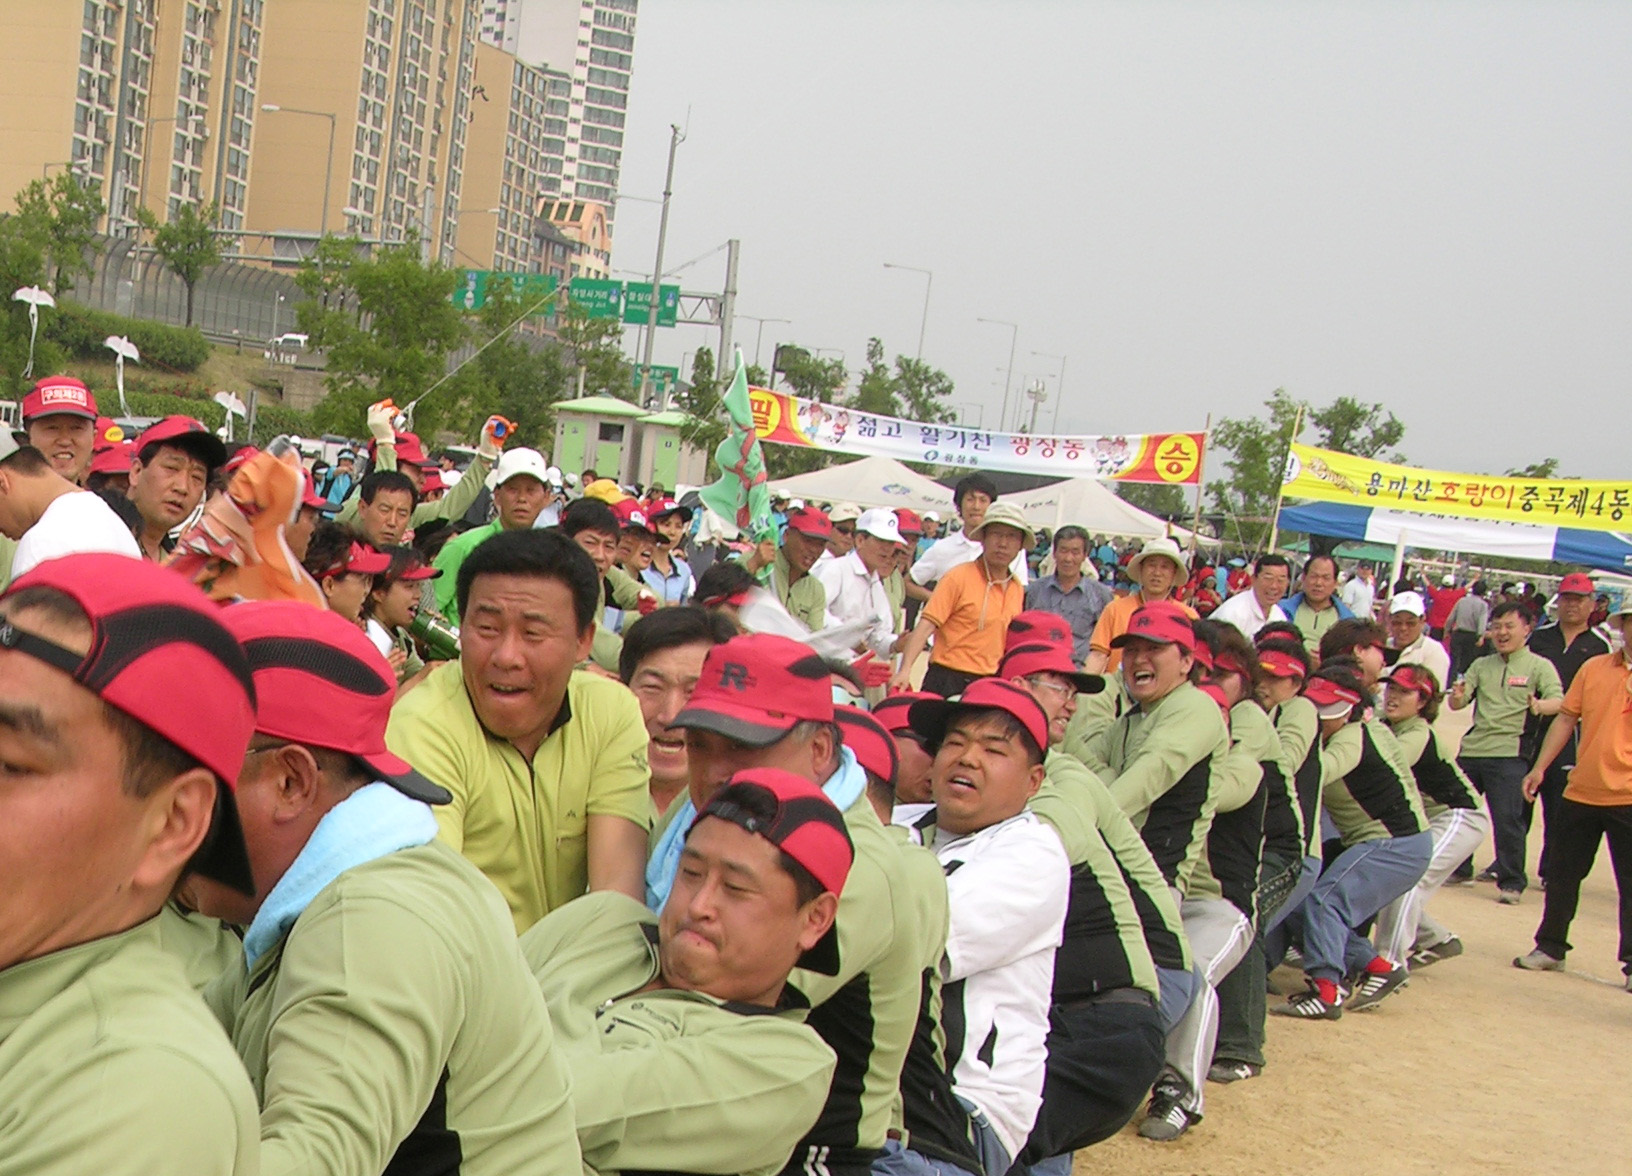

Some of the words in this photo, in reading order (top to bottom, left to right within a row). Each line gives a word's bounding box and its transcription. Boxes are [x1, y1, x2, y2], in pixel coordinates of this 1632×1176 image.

[750, 399, 772, 431] 필
[857, 416, 902, 438] 젊고
[920, 425, 994, 452] 활기찬
[1010, 434, 1085, 460] 광장동
[1160, 442, 1192, 475] 승
[1365, 471, 1433, 502] 용마산
[1434, 481, 1515, 509] 호랑이
[1519, 485, 1631, 521] 중곡제4동
[719, 662, 749, 691] R
